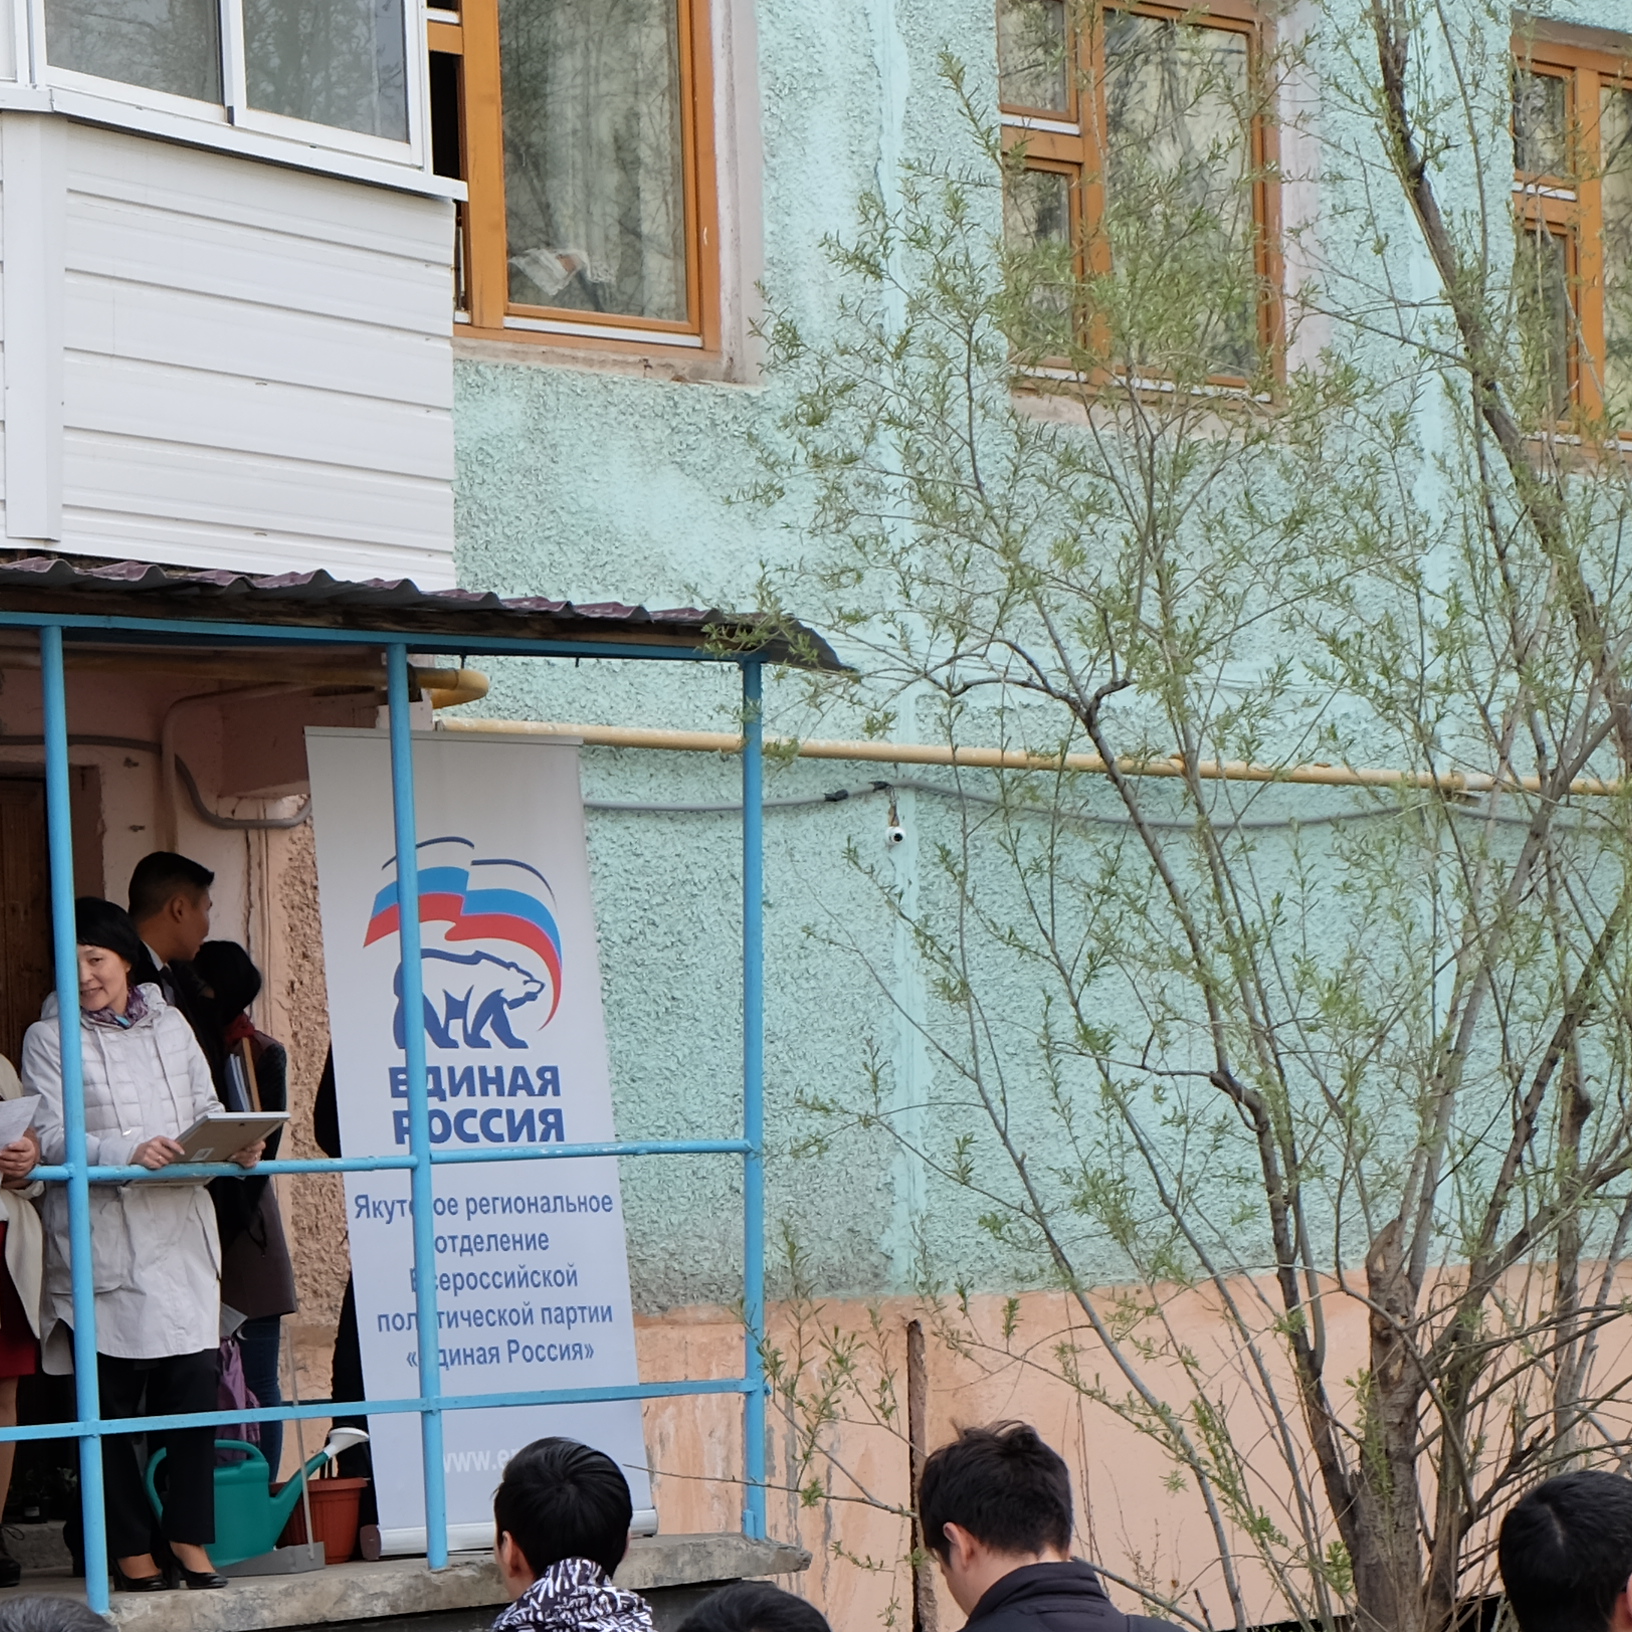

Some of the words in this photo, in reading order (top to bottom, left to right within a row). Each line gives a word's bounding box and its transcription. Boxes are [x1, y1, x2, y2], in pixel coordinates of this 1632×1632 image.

[392, 1107, 566, 1145] РОССИЯ
[353, 1193, 459, 1225] Якутое
[465, 1193, 614, 1222] региональное
[434, 1231, 550, 1258] отделение
[409, 1262, 579, 1298] ероссийской
[376, 1301, 535, 1333] полтической
[540, 1304, 614, 1331] партии
[406, 1341, 501, 1372] «диная
[506, 1338, 595, 1365] Россия»
